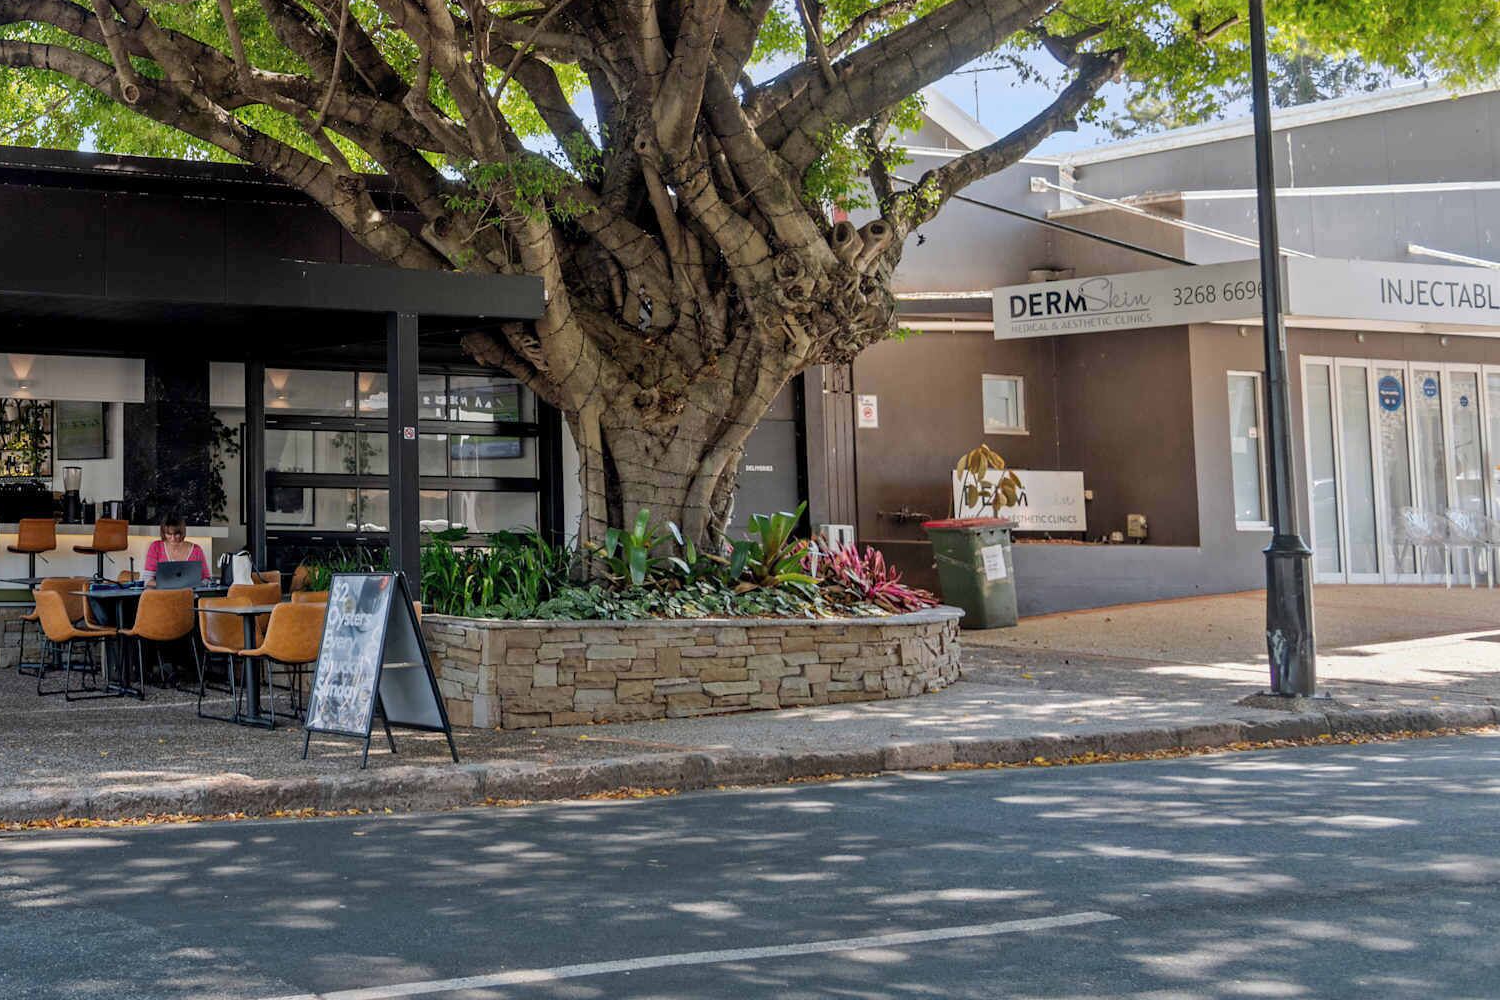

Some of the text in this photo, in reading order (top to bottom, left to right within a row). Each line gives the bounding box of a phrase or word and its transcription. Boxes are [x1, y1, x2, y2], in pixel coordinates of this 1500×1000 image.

[1173, 285, 1216, 306] 3268
[1380, 278, 1500, 310] INJECTABL
[1011, 319, 1049, 333] MEDICAL
[1060, 315, 1112, 329] AESTHETIC
[1114, 313, 1153, 325] CLINICS
[332, 581, 350, 602] $2
[328, 606, 373, 632] Oysters
